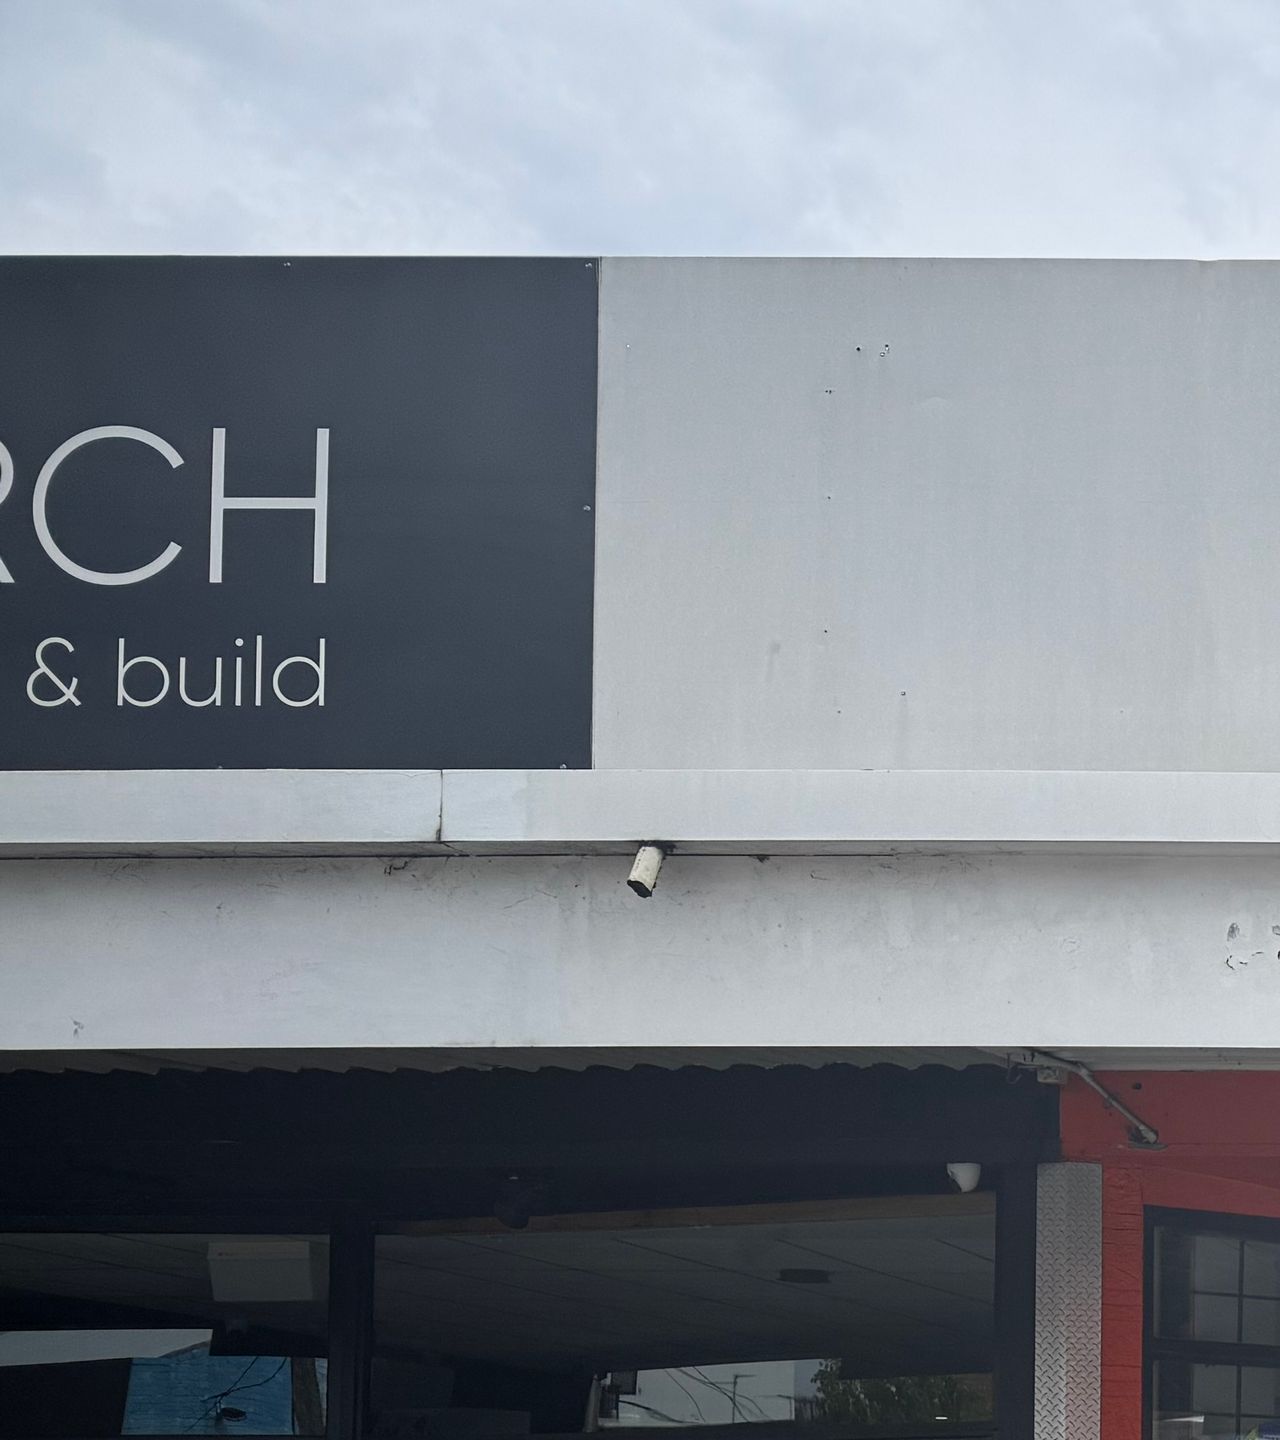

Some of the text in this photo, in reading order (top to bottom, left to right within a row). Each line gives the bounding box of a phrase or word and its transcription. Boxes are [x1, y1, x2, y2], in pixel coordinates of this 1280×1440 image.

[0, 425, 330, 586] CH
[26, 635, 326, 708] & build
